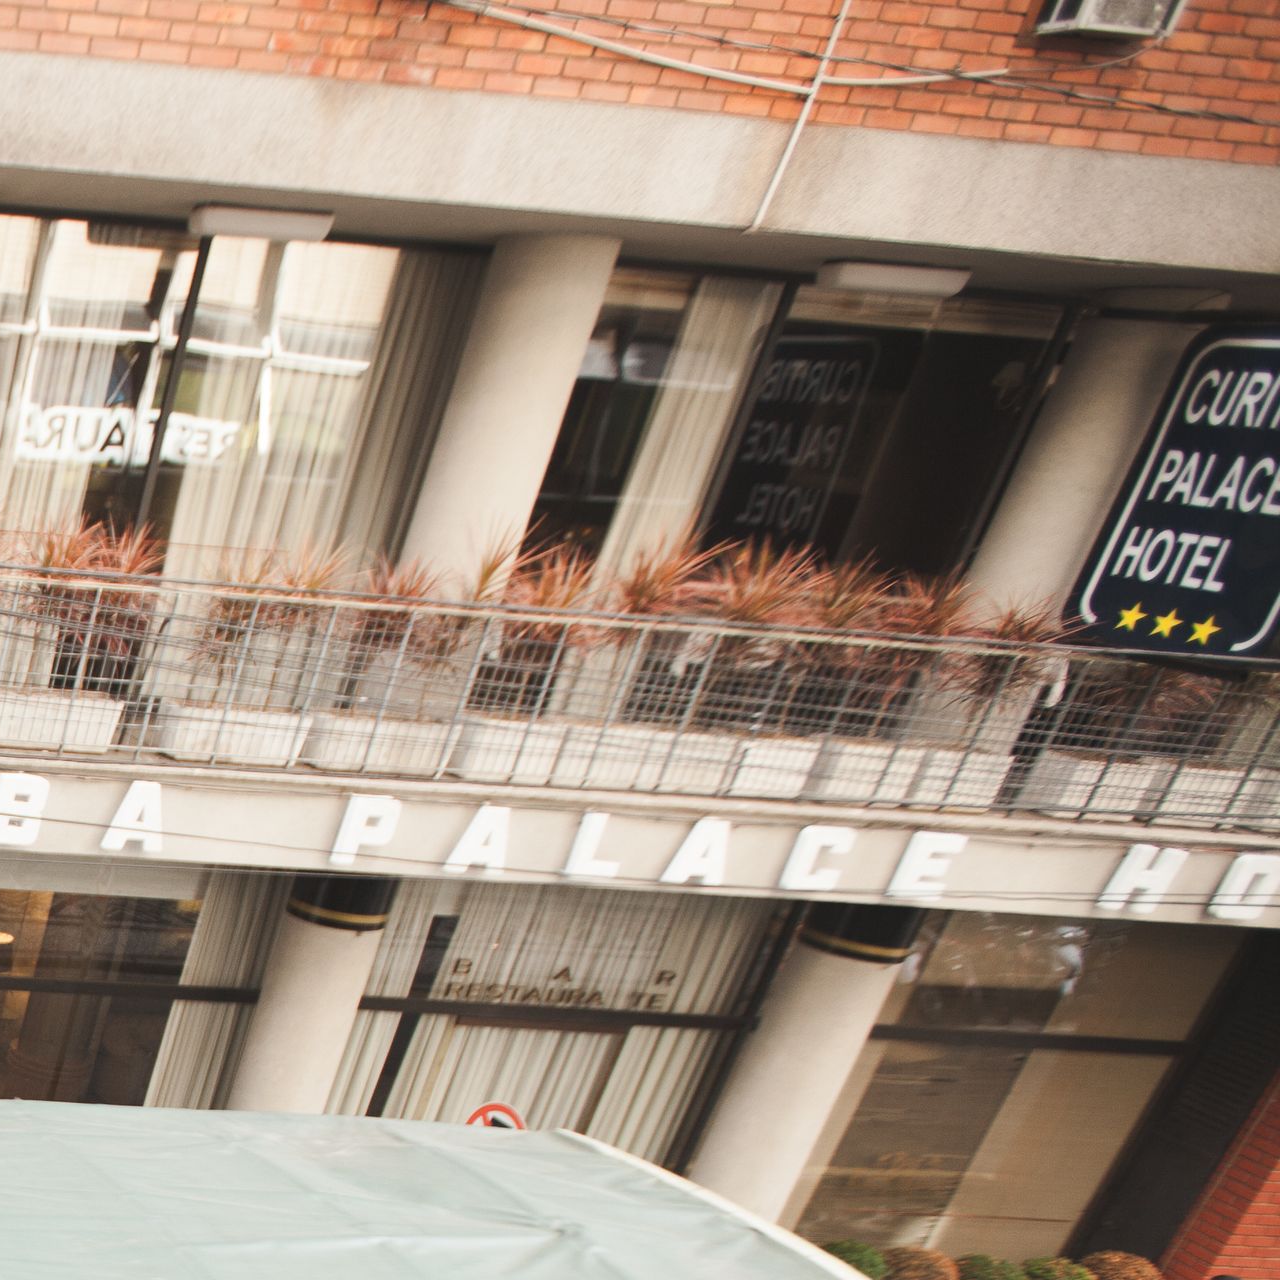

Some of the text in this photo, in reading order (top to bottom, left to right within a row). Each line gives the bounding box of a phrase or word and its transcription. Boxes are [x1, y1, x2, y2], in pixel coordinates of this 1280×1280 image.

[1185, 368, 1280, 428] CURI
[1146, 449, 1280, 515] PALACE
[1110, 525, 1231, 592] HOTEL
[329, 794, 968, 901] PALACE
[1096, 842, 1280, 920] HO
